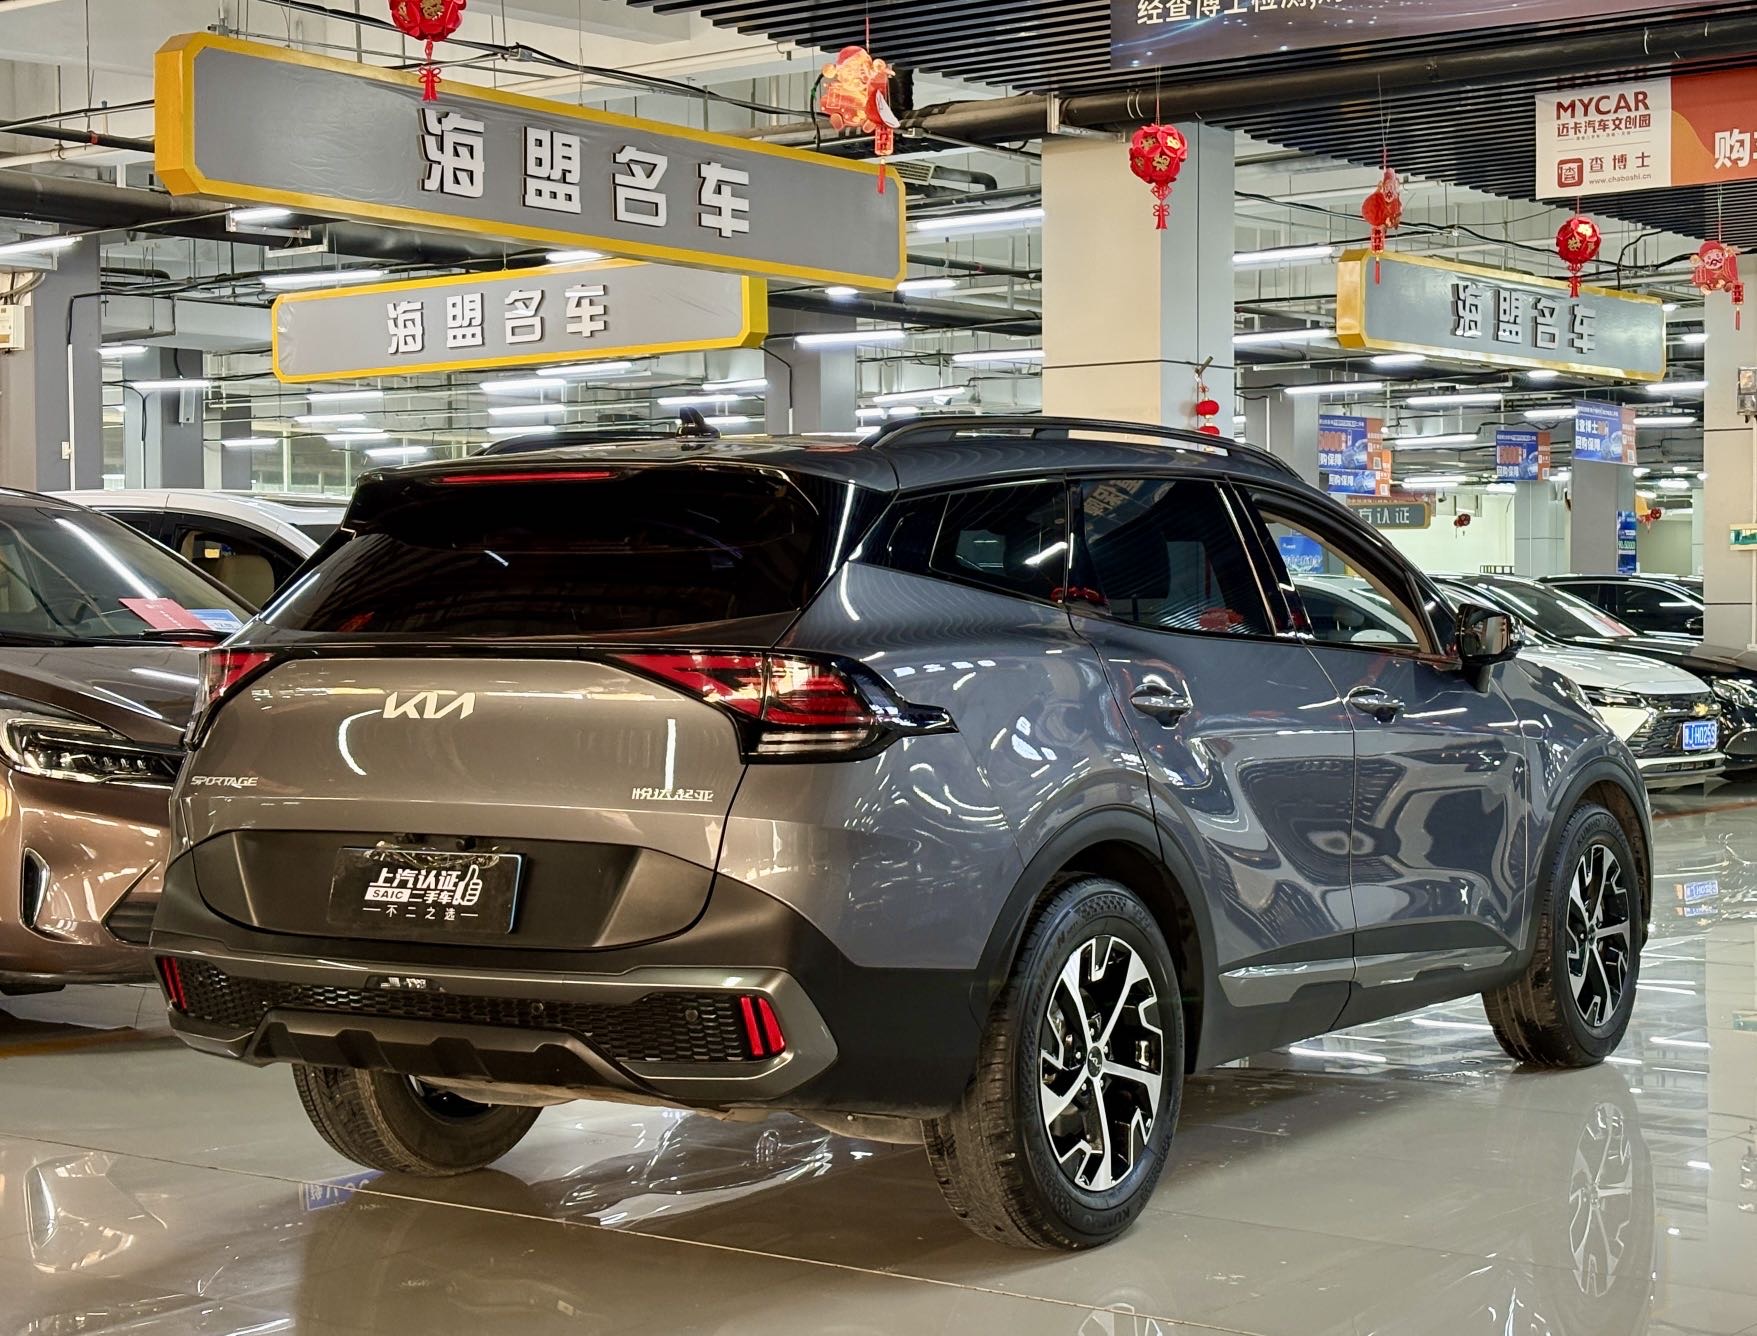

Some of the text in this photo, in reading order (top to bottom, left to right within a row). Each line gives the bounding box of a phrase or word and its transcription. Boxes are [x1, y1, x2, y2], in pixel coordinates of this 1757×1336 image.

[1556, 90, 1650, 120] MYCAR
[1557, 113, 1651, 137] 迈卡汽车文创园
[1714, 128, 1757, 170] 购
[418, 107, 750, 238] 海盟名车
[386, 284, 606, 354] 海盟名车
[1452, 282, 1596, 354] 海盟名车
[383, 691, 476, 720] KIA
[191, 775, 259, 789] SPORTAGE
[369, 867, 461, 891] 上汽认证
[372, 889, 405, 900] SAIC
[408, 890, 455, 905] 二手车
[385, 904, 457, 921] 不二之选
